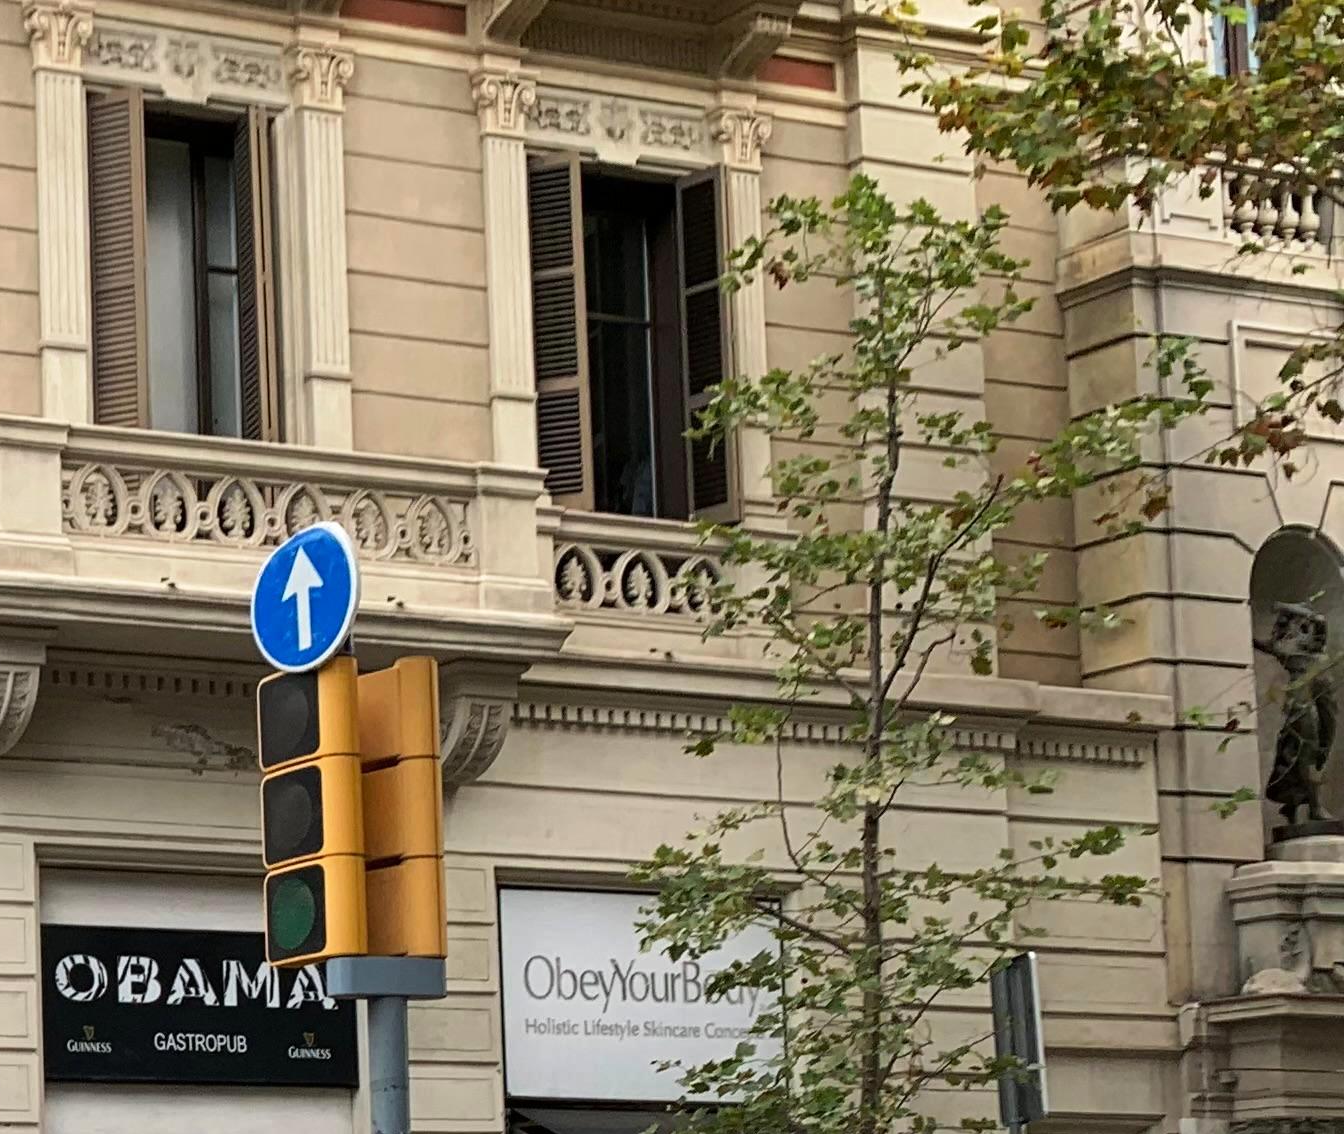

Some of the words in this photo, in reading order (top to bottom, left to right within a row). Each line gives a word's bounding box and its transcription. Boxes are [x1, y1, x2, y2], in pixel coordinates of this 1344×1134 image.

[55, 953, 339, 1010] OBAMA
[524, 1017, 580, 1036] Holistic
[584, 1019, 640, 1041] Lifestyle
[643, 1021, 701, 1038] Skincare
[66, 1039, 112, 1054] GUINNESS
[153, 1032, 248, 1053] GASTROPUB
[287, 1046, 332, 1060] GUINNESS
